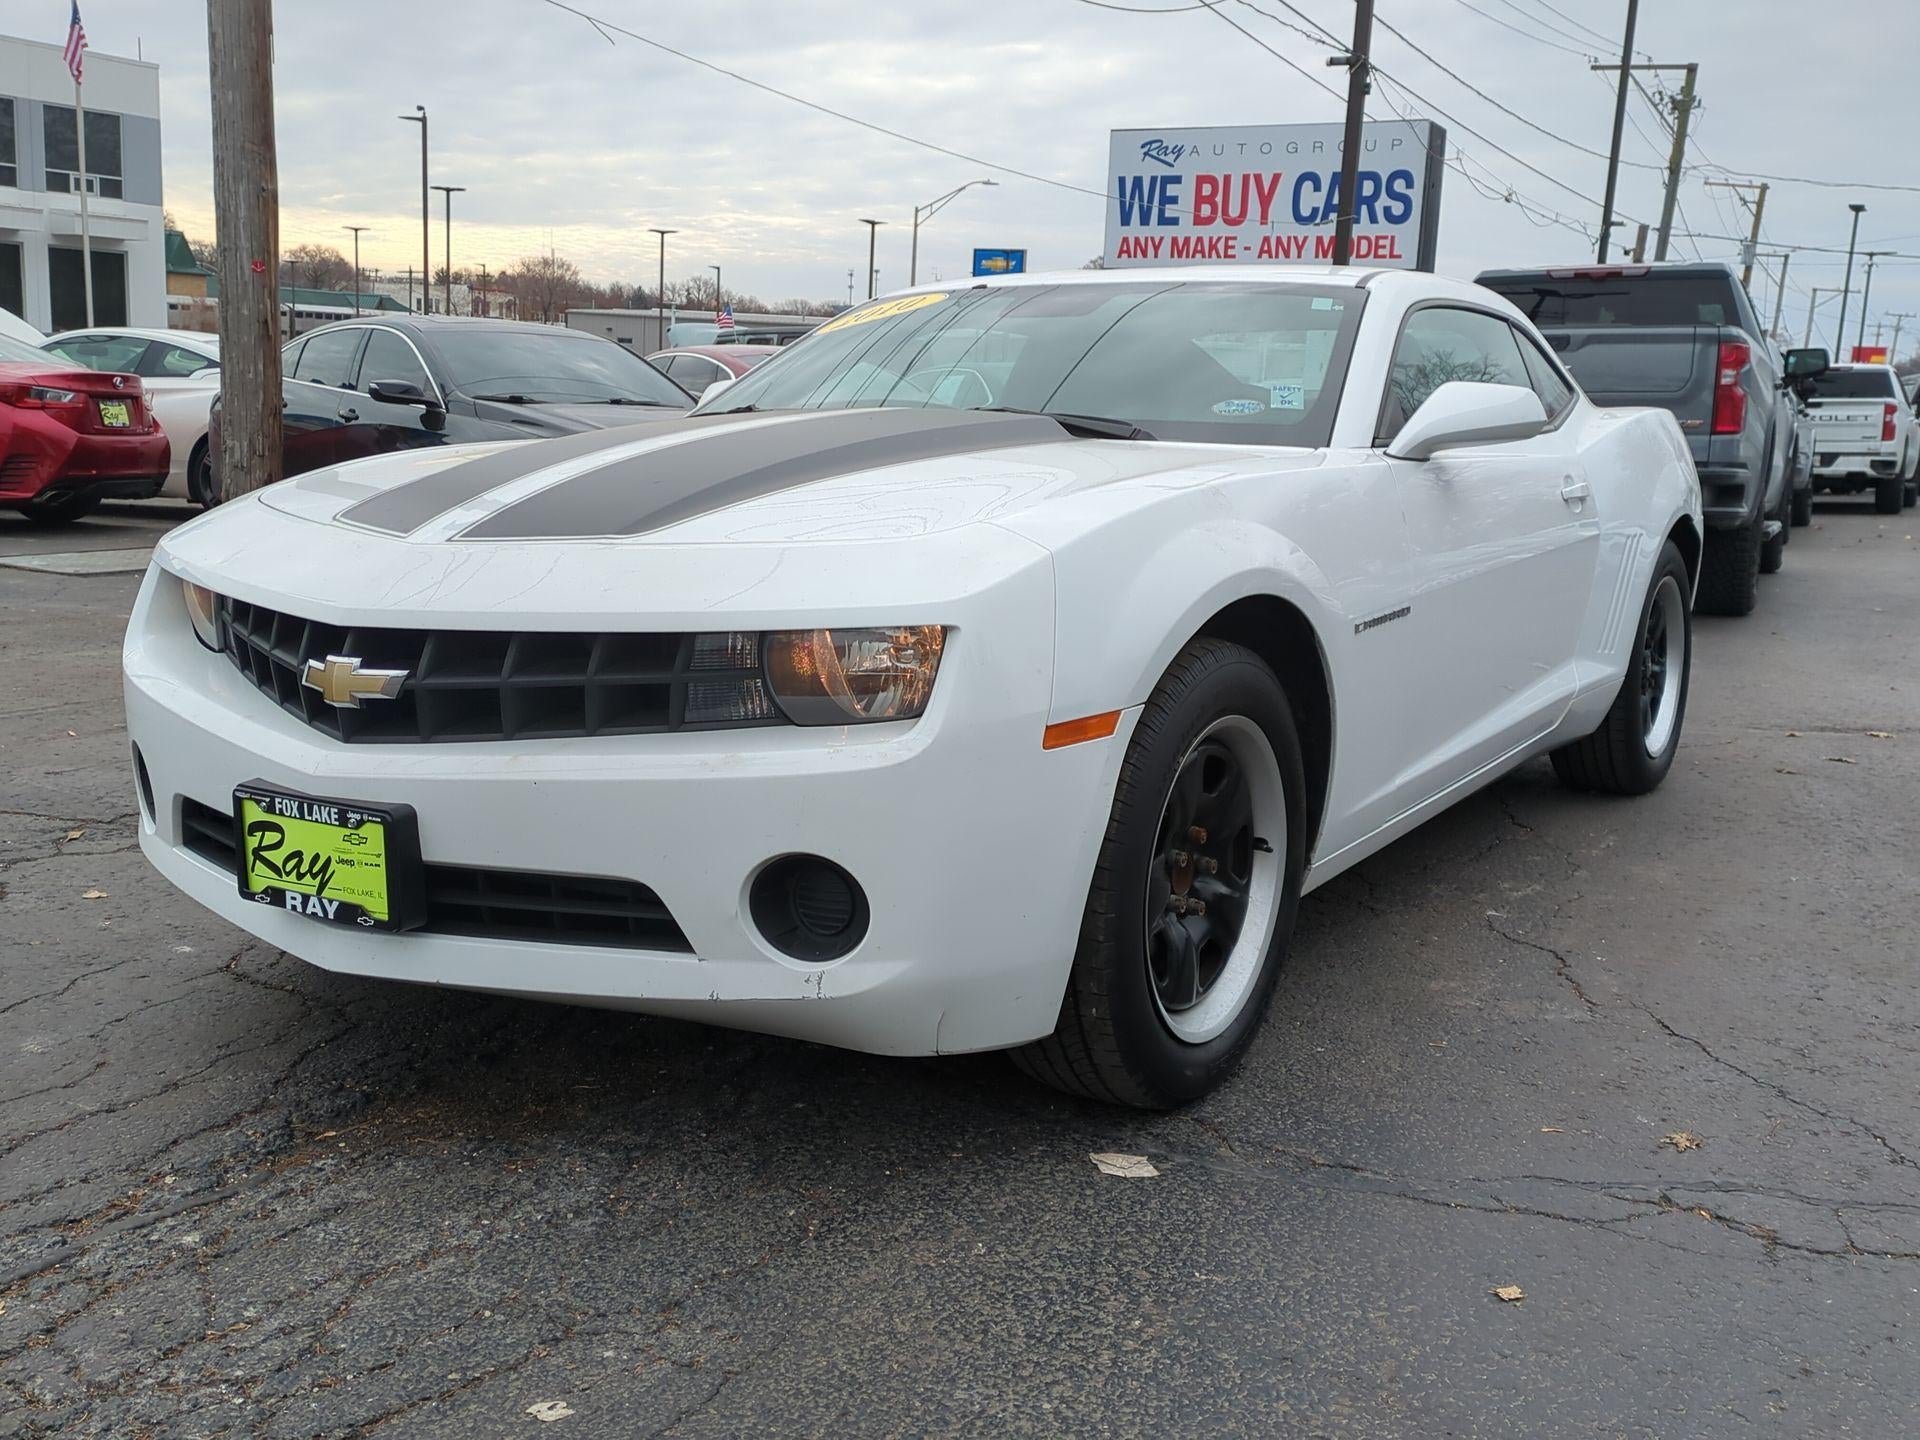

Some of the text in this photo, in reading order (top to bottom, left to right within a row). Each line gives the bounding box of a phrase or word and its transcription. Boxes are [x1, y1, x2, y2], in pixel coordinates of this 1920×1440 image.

[1140, 138, 1185, 168] Ray
[1117, 169, 1416, 227] WE BUY CARS
[1117, 236, 1166, 259] ANY
[1169, 235, 1238, 260] MAKE
[1257, 235, 1309, 260] ANY
[274, 797, 340, 826] FOX LAKE
[247, 820, 335, 896] Ray
[335, 855, 355, 868] Jeep
[285, 890, 340, 919] RAY
[342, 886, 357, 896] FOX
